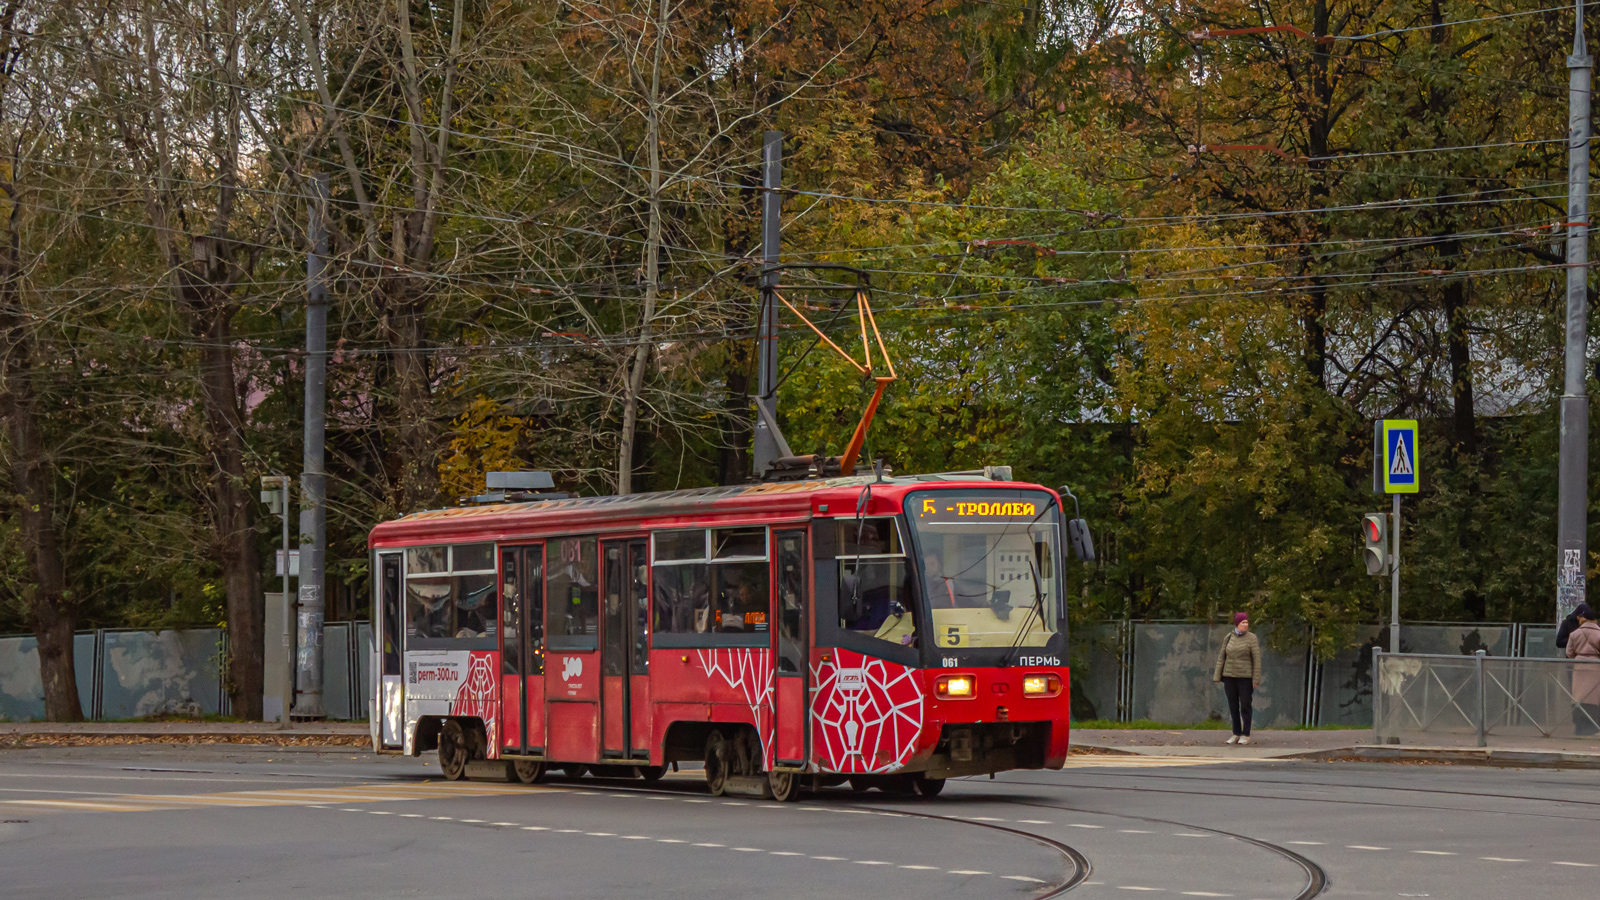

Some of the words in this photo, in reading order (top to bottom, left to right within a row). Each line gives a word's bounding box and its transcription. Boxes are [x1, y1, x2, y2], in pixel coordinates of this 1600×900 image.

[560, 539, 581, 562] 061
[947, 628, 960, 645] 5
[562, 657, 583, 681] 300
[942, 658, 958, 668] 061
[1019, 656, 1061, 666] ПЕРМЬ
[418, 667, 458, 684] perm-300.ru
